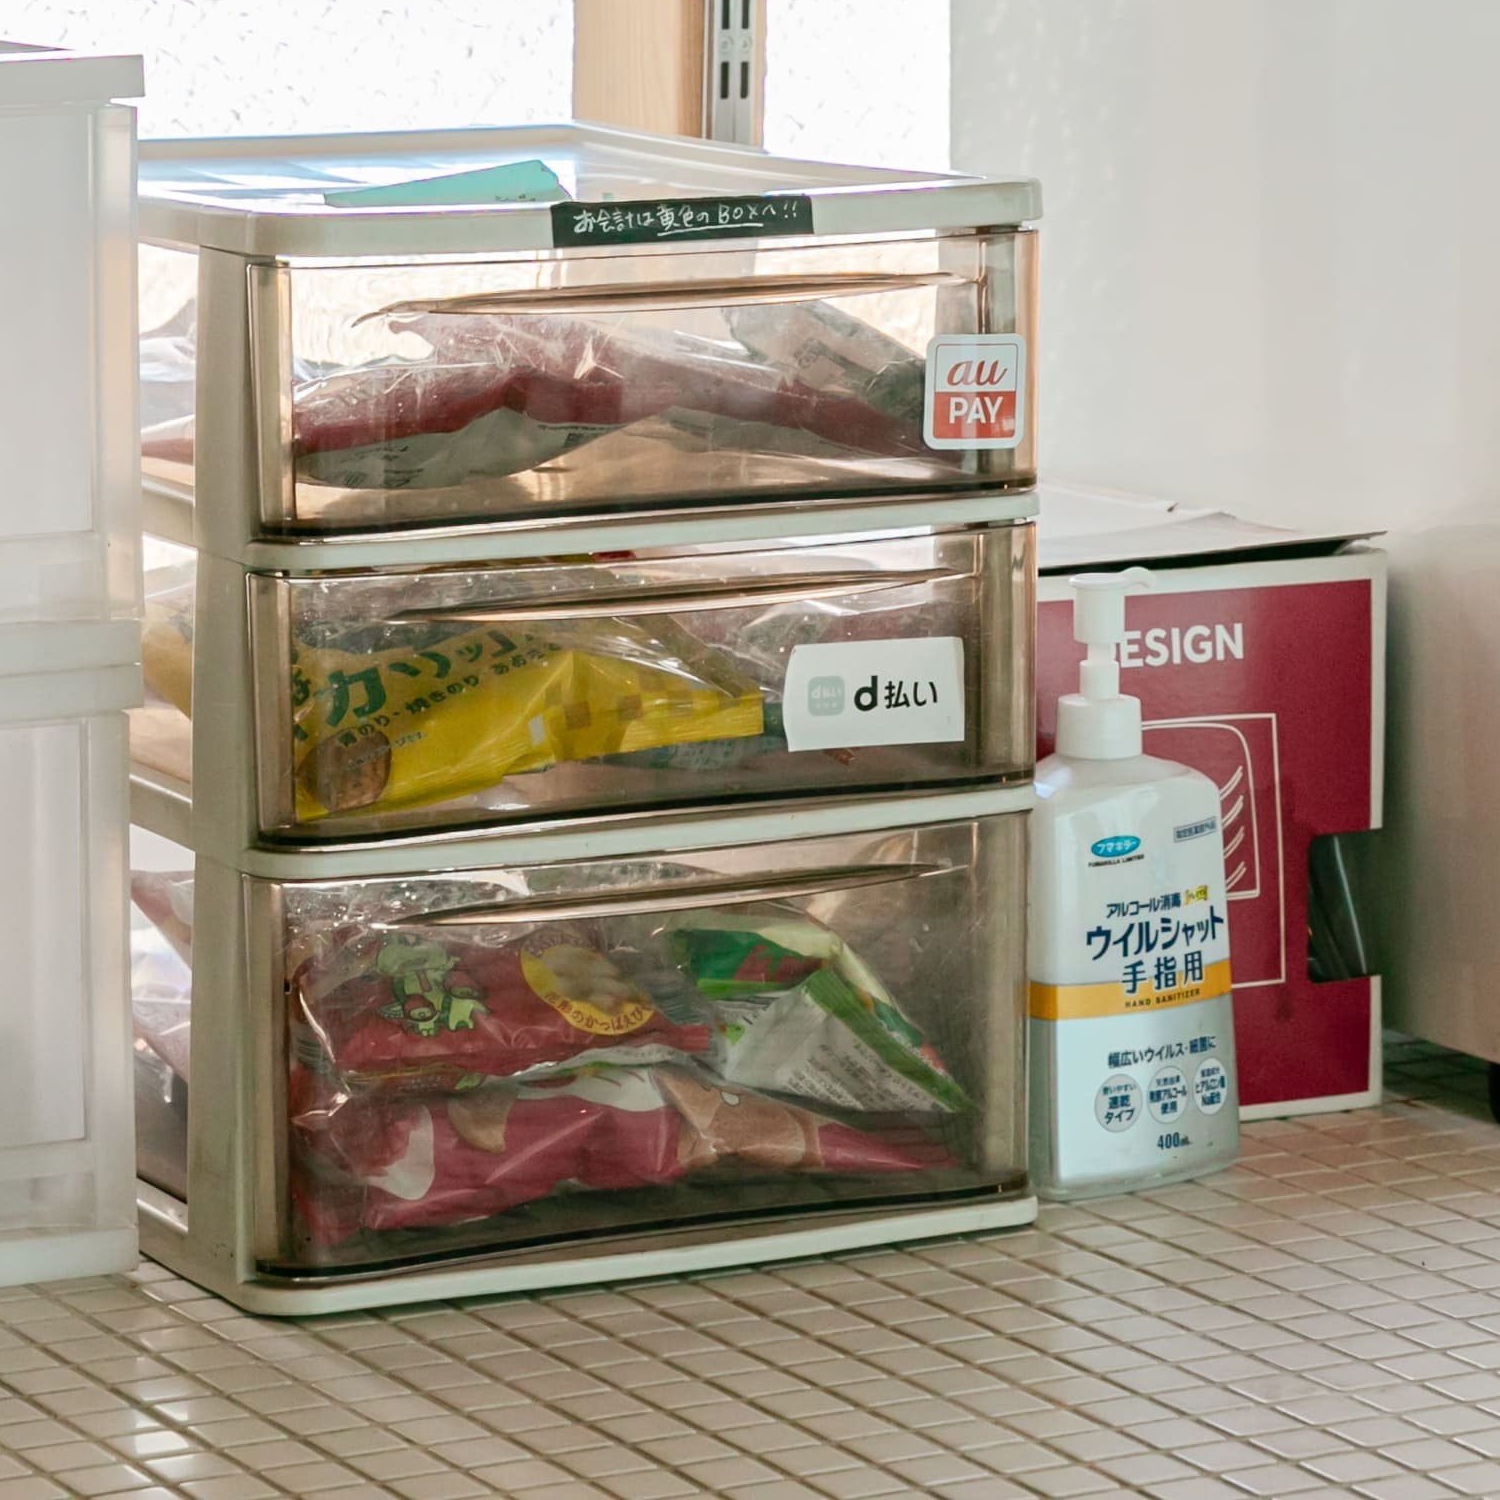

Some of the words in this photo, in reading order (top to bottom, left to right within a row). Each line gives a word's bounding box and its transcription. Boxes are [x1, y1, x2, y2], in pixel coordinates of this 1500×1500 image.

[946, 359, 1008, 387] au
[948, 396, 1004, 424] PAY
[1113, 622, 1245, 669] ESIGN
[853, 674, 938, 712] d払い
[1086, 905, 1224, 961] ウイルシャット
[1121, 950, 1204, 994] 手指用
[1125, 998, 1151, 1008] HAND
[1155, 988, 1201, 1004] SANITIZER
